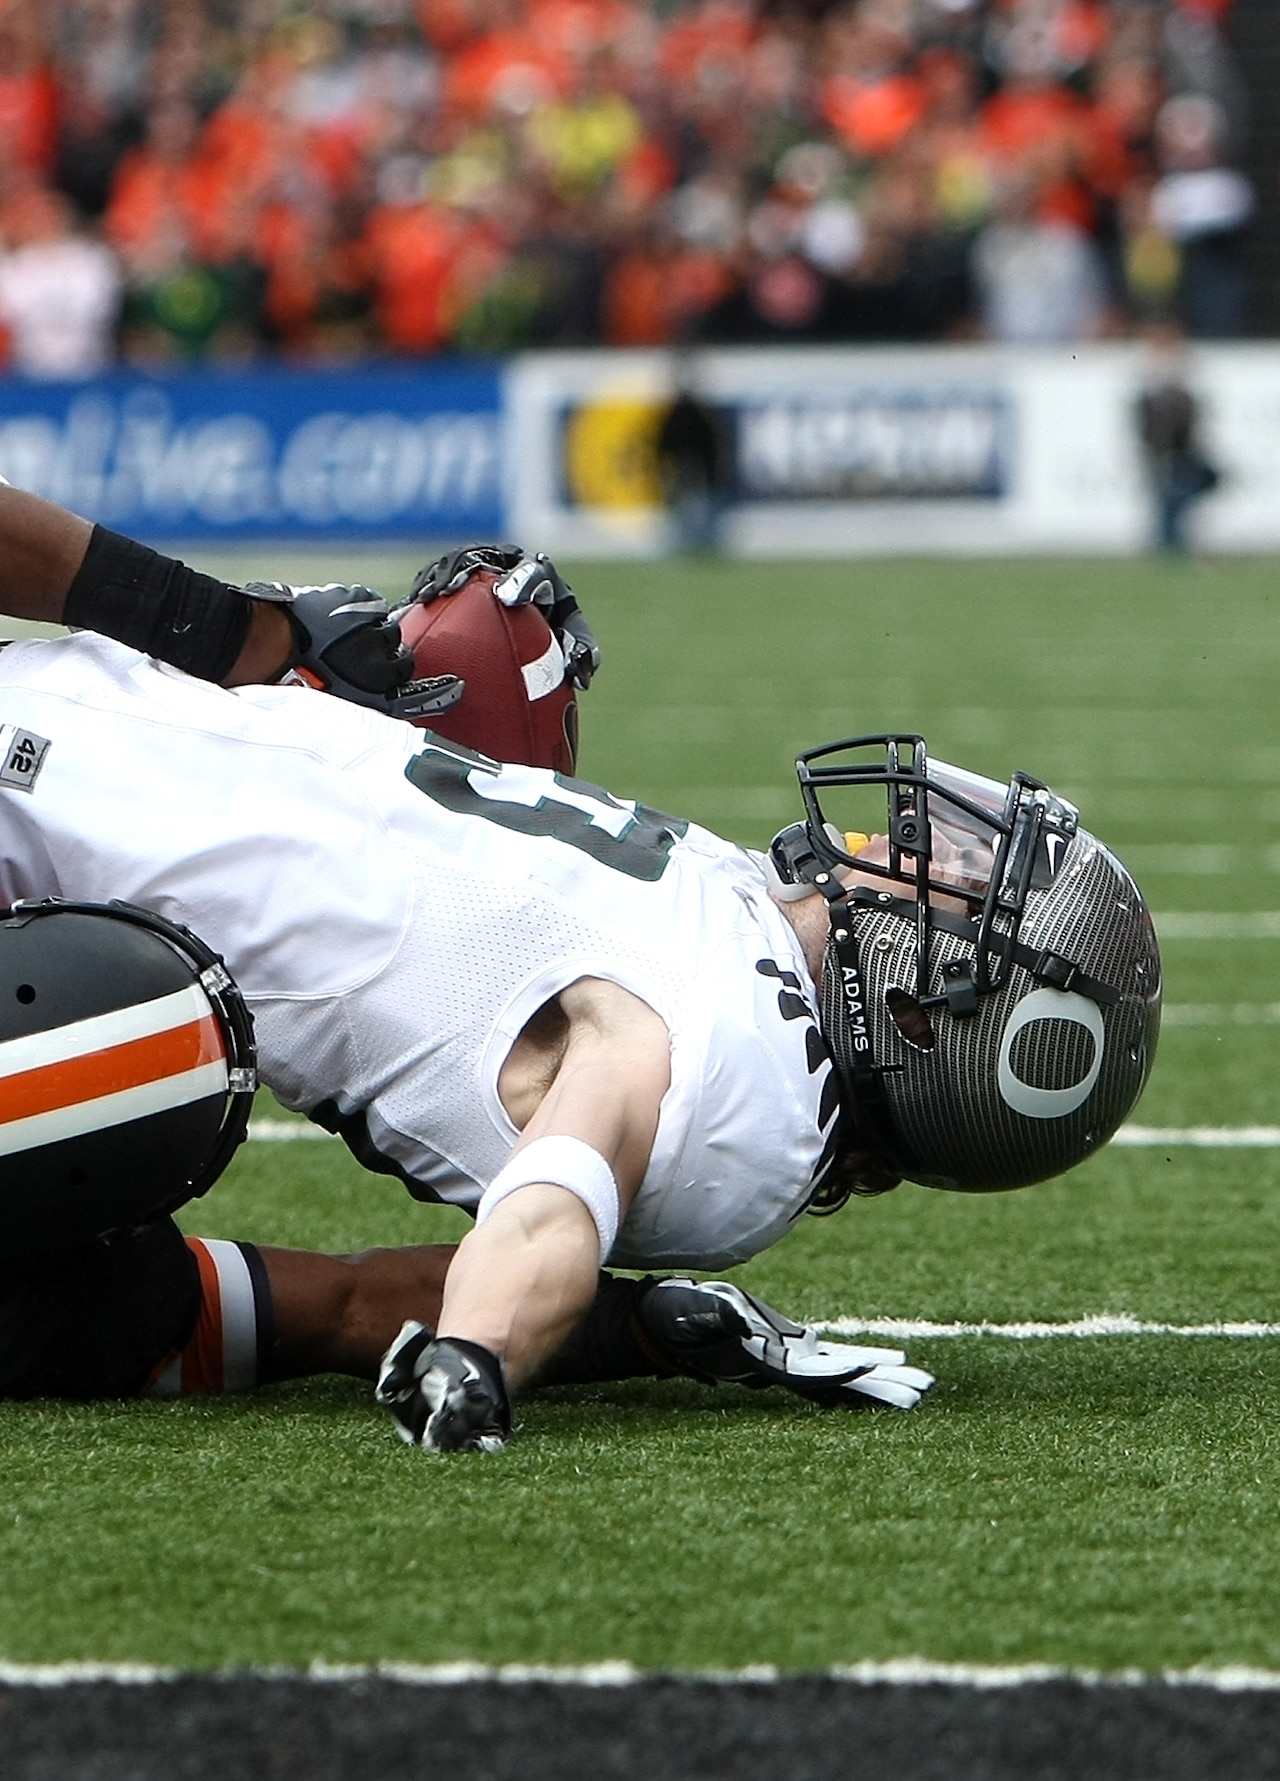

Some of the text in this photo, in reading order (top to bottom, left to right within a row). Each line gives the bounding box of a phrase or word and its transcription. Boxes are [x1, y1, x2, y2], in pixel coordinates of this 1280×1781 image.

[9, 738, 36, 773] 42
[841, 966, 869, 1052] ADAMS
[998, 986, 1105, 1118] O
